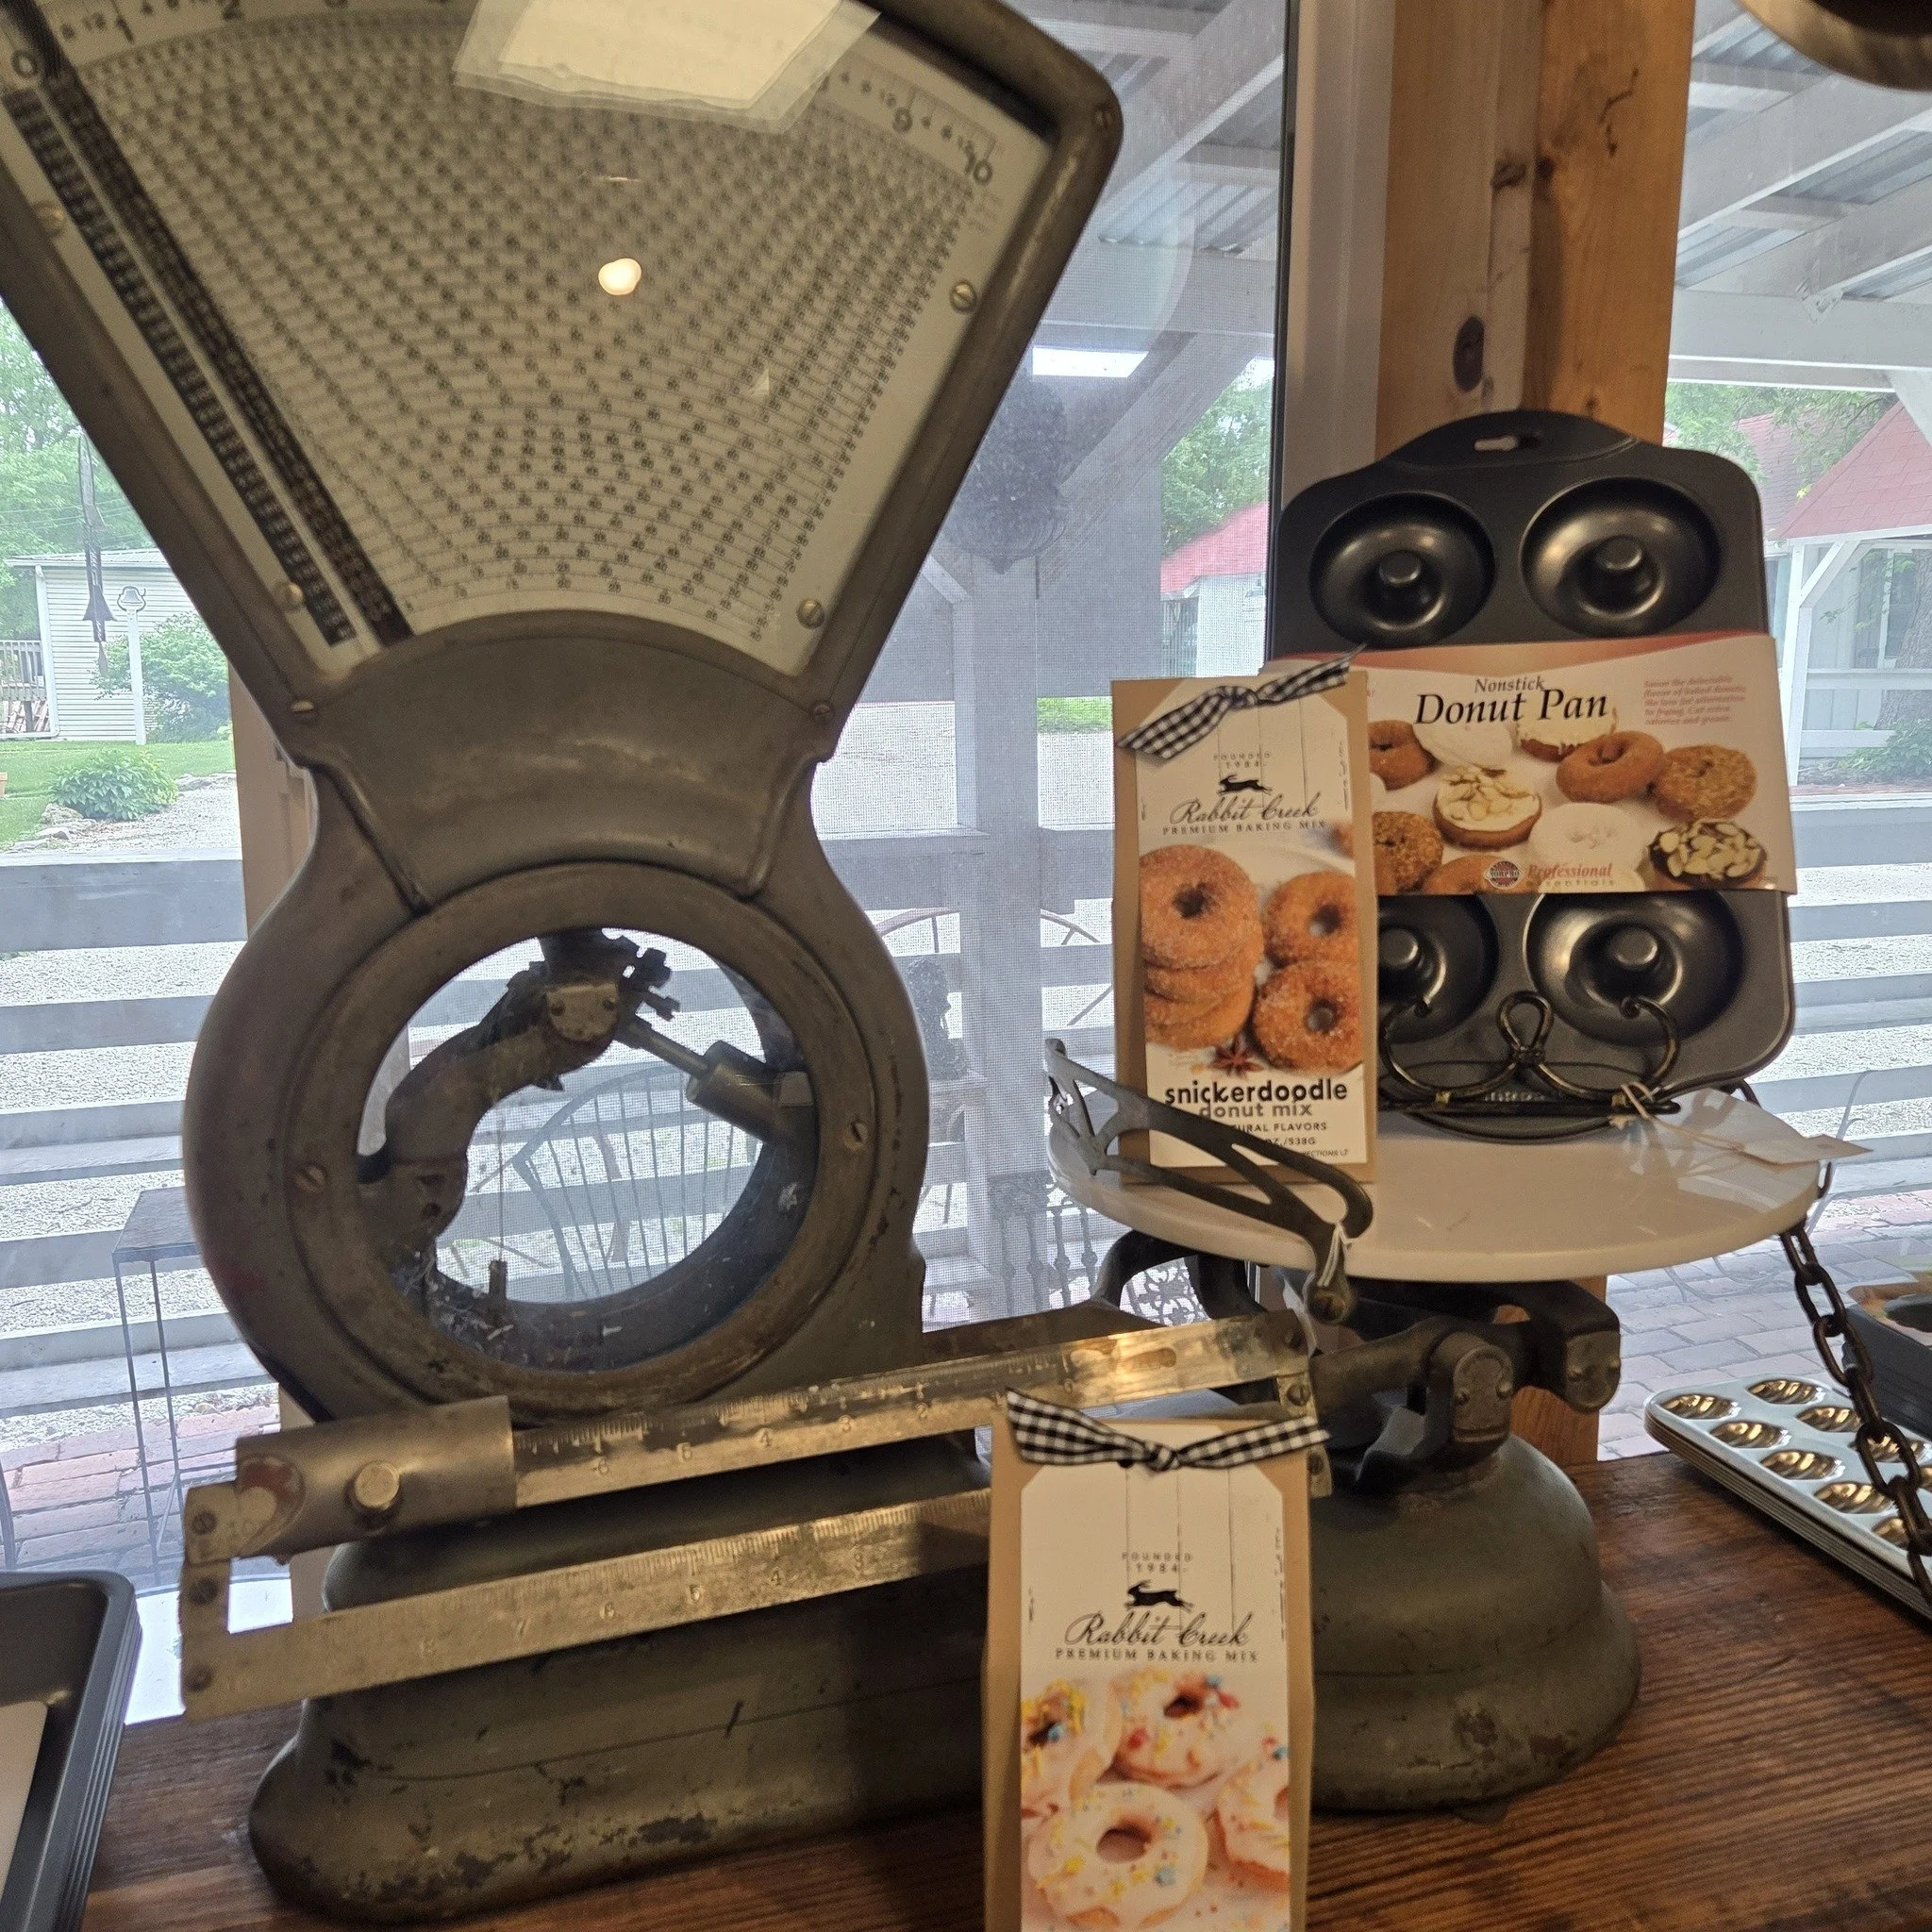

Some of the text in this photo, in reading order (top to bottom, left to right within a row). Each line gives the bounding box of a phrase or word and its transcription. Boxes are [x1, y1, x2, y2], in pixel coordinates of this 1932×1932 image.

[1474, 675, 1545, 693] Nonstick
[1414, 689, 1607, 724] Donut Pan
[1170, 795, 1253, 825] Rabbit
[1261, 792, 1323, 820] Creek
[1162, 820, 1325, 836] PREMIUM BAKING MIX
[1527, 862, 1614, 878] Professional
[1164, 1078, 1348, 1104] snickerdoodle
[1199, 1101, 1313, 1120] donut mix
[1274, 1122, 1327, 1132] FLAVORS
[1122, 1552, 1194, 1561] FOUNDED
[769, 1567, 783, 1586] 4
[1064, 1610, 1254, 1647] Rabbit Creek
[1056, 1649, 1259, 1663] PREMIUM BAKING MIX
